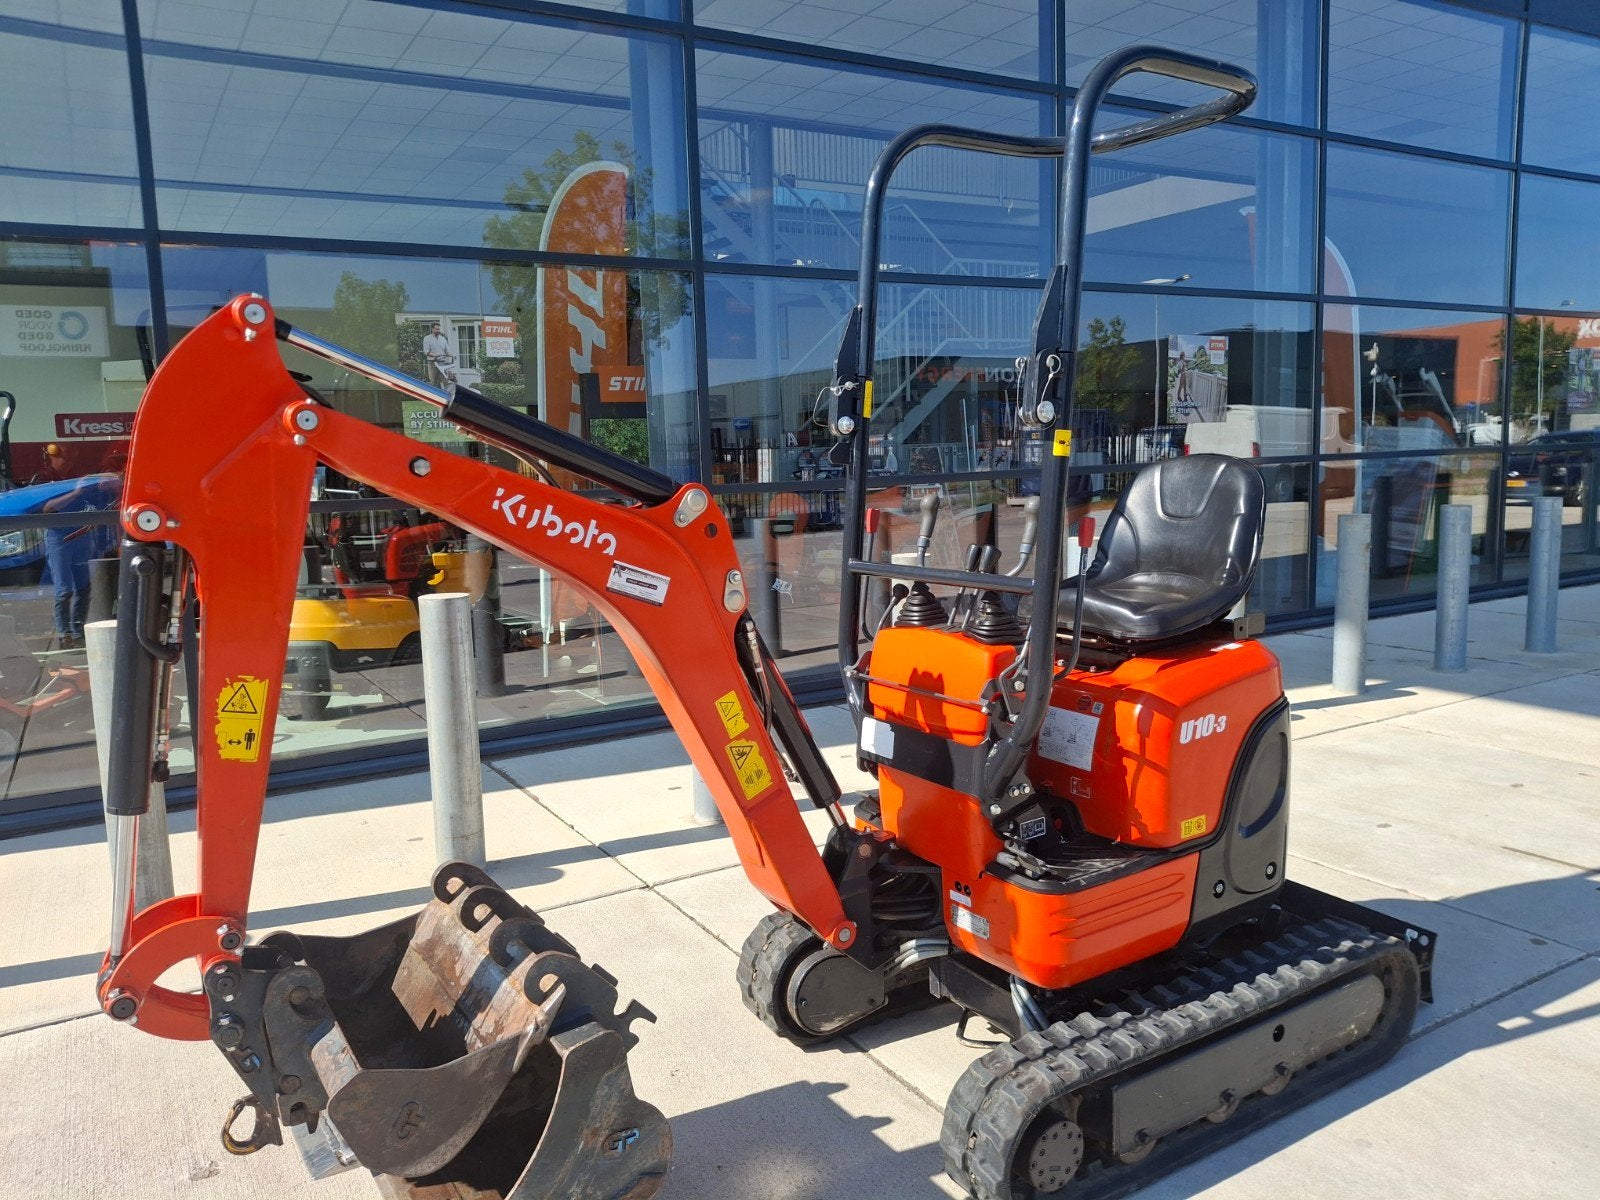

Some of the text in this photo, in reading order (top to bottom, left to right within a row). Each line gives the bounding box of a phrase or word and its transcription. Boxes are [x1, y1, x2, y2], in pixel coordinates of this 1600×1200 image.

[485, 325, 512, 334] STIHL
[410, 410, 441, 419] ACCU
[63, 418, 125, 435] Kress
[411, 420, 423, 429] BY
[492, 487, 617, 556] Kubota
[1179, 713, 1228, 745] U10-3
